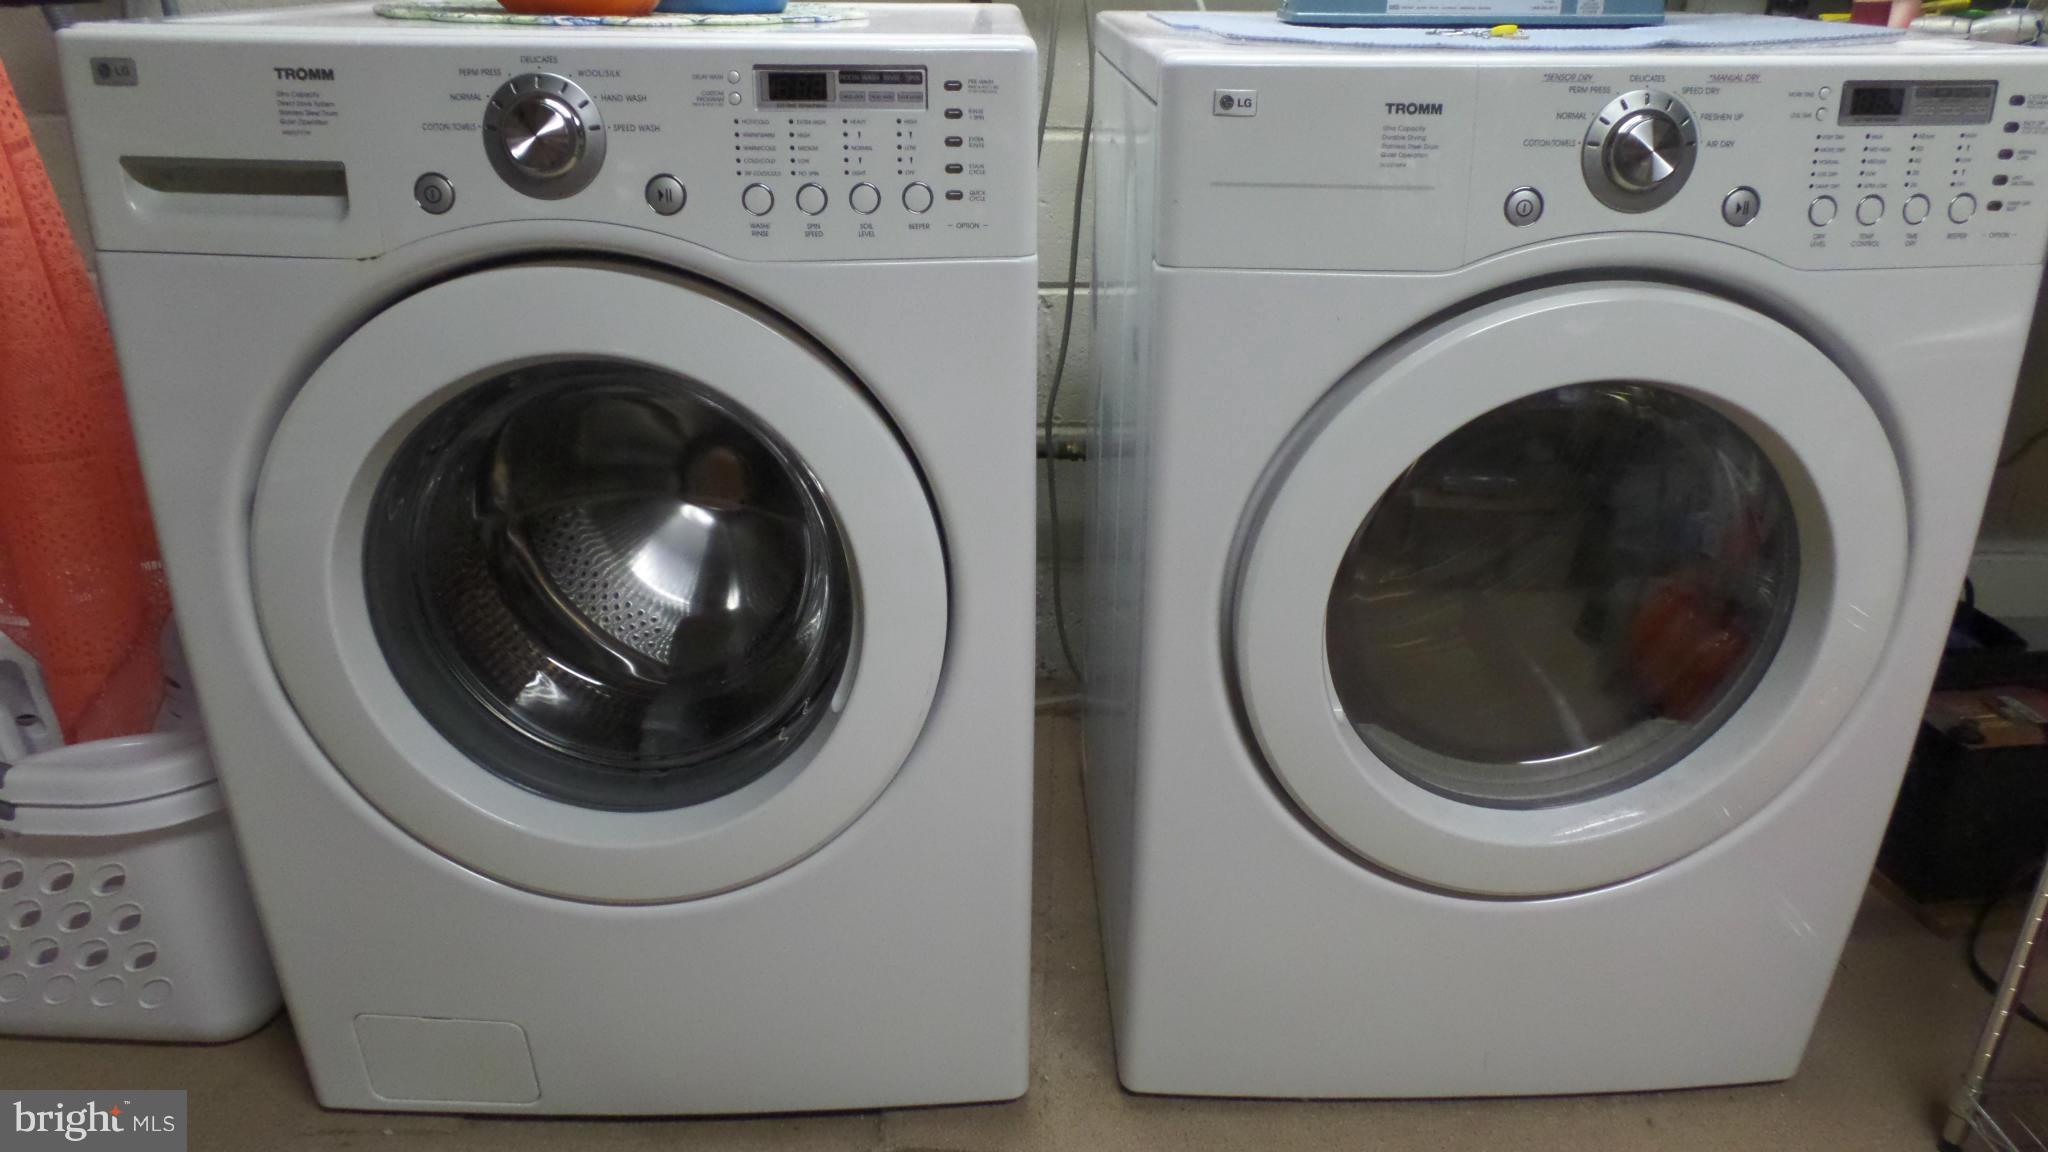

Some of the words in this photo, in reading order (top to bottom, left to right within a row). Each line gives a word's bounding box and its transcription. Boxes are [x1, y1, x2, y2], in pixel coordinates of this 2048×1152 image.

[519, 55, 559, 64] DELICATES
[113, 65, 131, 77] LG
[273, 67, 335, 81] TROMM
[480, 67, 502, 77] PRESS
[577, 69, 621, 78] WOOL/SILK
[1578, 73, 1594, 82] DRY
[1629, 74, 1667, 83] DELICATES
[1744, 73, 1761, 83] DRY
[1568, 85, 1589, 94] PERM
[1590, 85, 1611, 95] PRESS
[1681, 86, 1704, 95] SPEED
[1705, 86, 1721, 95] DRY
[448, 92, 482, 101] NORMAL
[600, 93, 624, 102] HAND
[625, 93, 648, 102] WASH
[1237, 98, 1253, 108] LG
[1384, 102, 1444, 116] TROMM
[1556, 111, 1587, 121] NORMAL
[1700, 112, 1732, 121] FRESHEN
[1733, 112, 1745, 121] UP
[612, 123, 637, 132] SPEED
[638, 123, 661, 132] WASH
[1706, 139, 1720, 149] AIR
[1720, 139, 1736, 149] DRY
[907, 222, 930, 230] BEEPER
[955, 221, 980, 230] OPTION
[804, 230, 825, 238] SPEED
[858, 230, 877, 238] LEVEL
